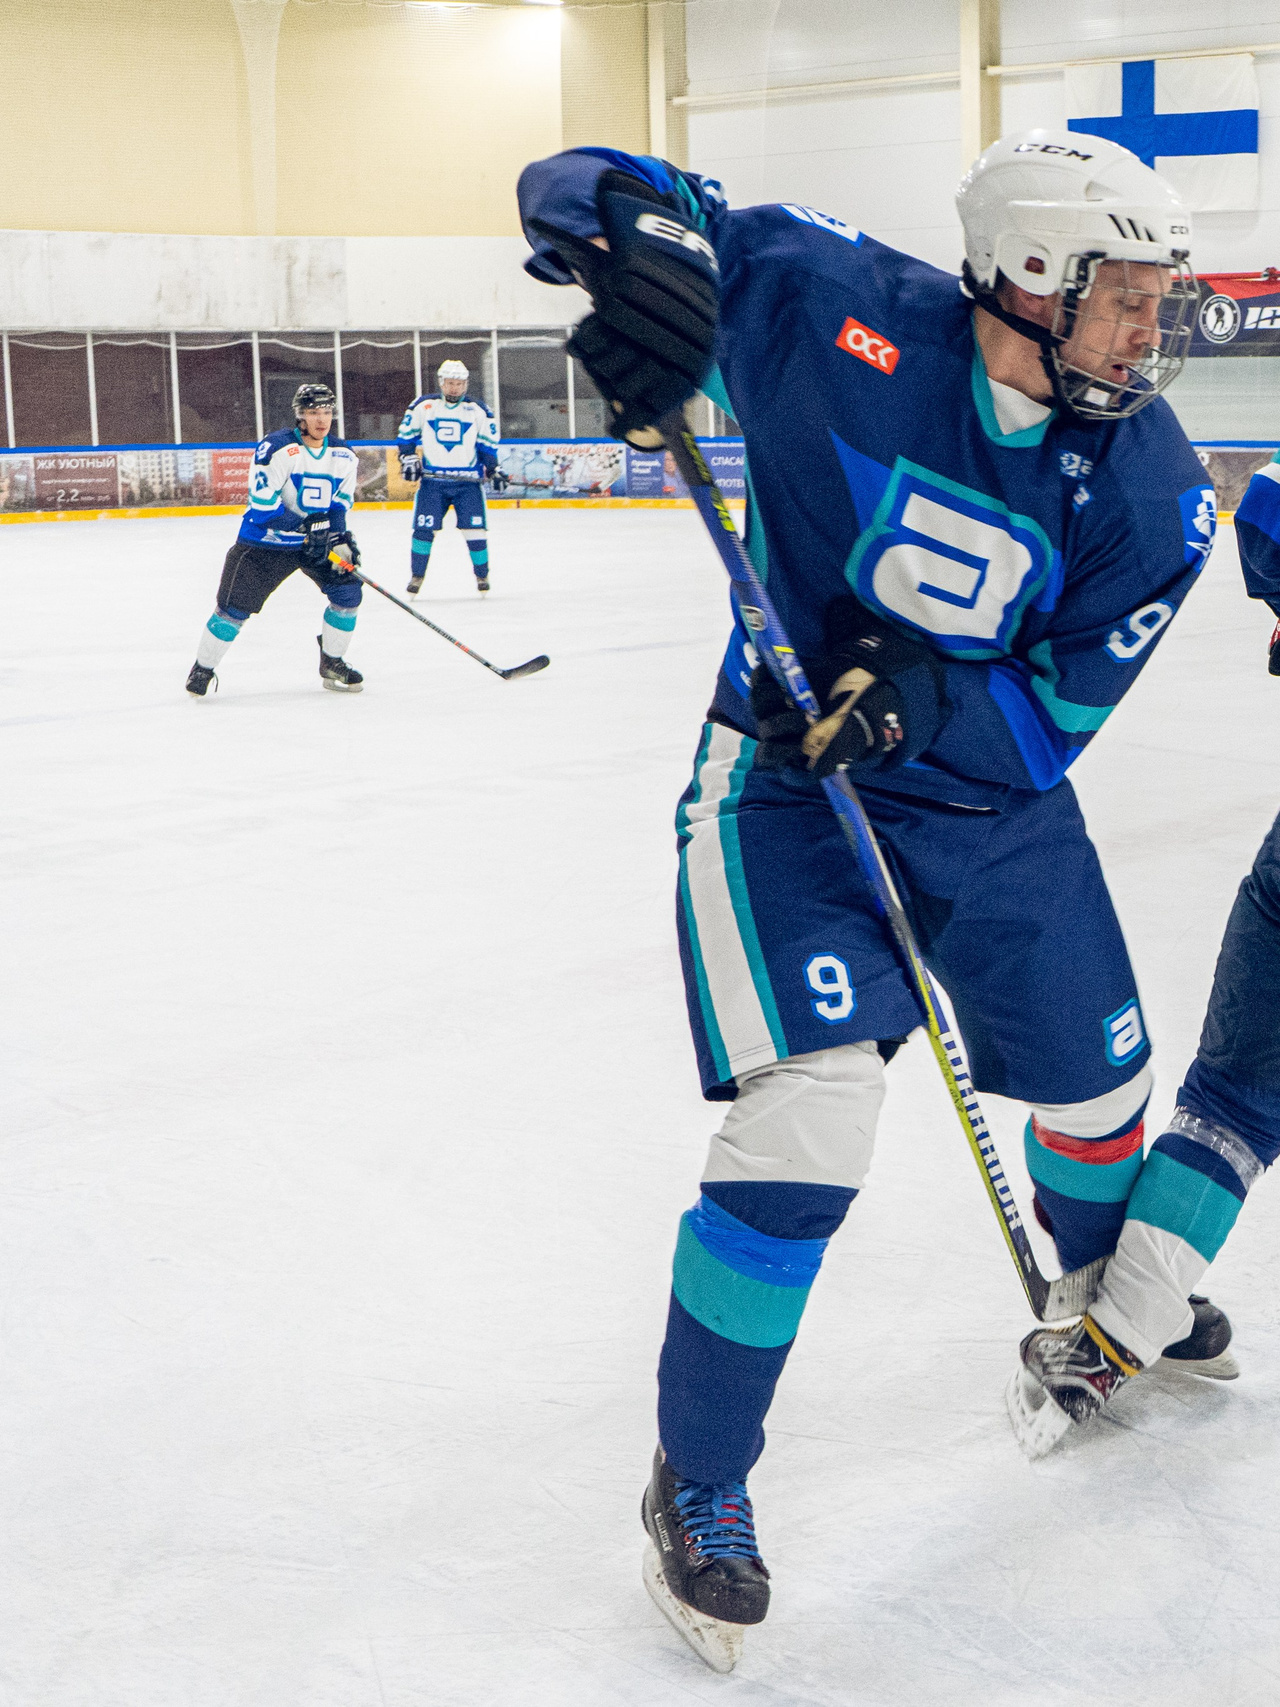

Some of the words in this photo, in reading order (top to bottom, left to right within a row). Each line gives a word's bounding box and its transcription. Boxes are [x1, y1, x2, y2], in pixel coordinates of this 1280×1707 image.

[1014, 143, 1093, 161] CCM
[57, 456, 115, 469] УЮТНЫЙ
[417, 514, 434, 527] 93
[1105, 600, 1174, 659] 9
[806, 955, 853, 1022] 9
[938, 1030, 1023, 1232] WARRIOR
